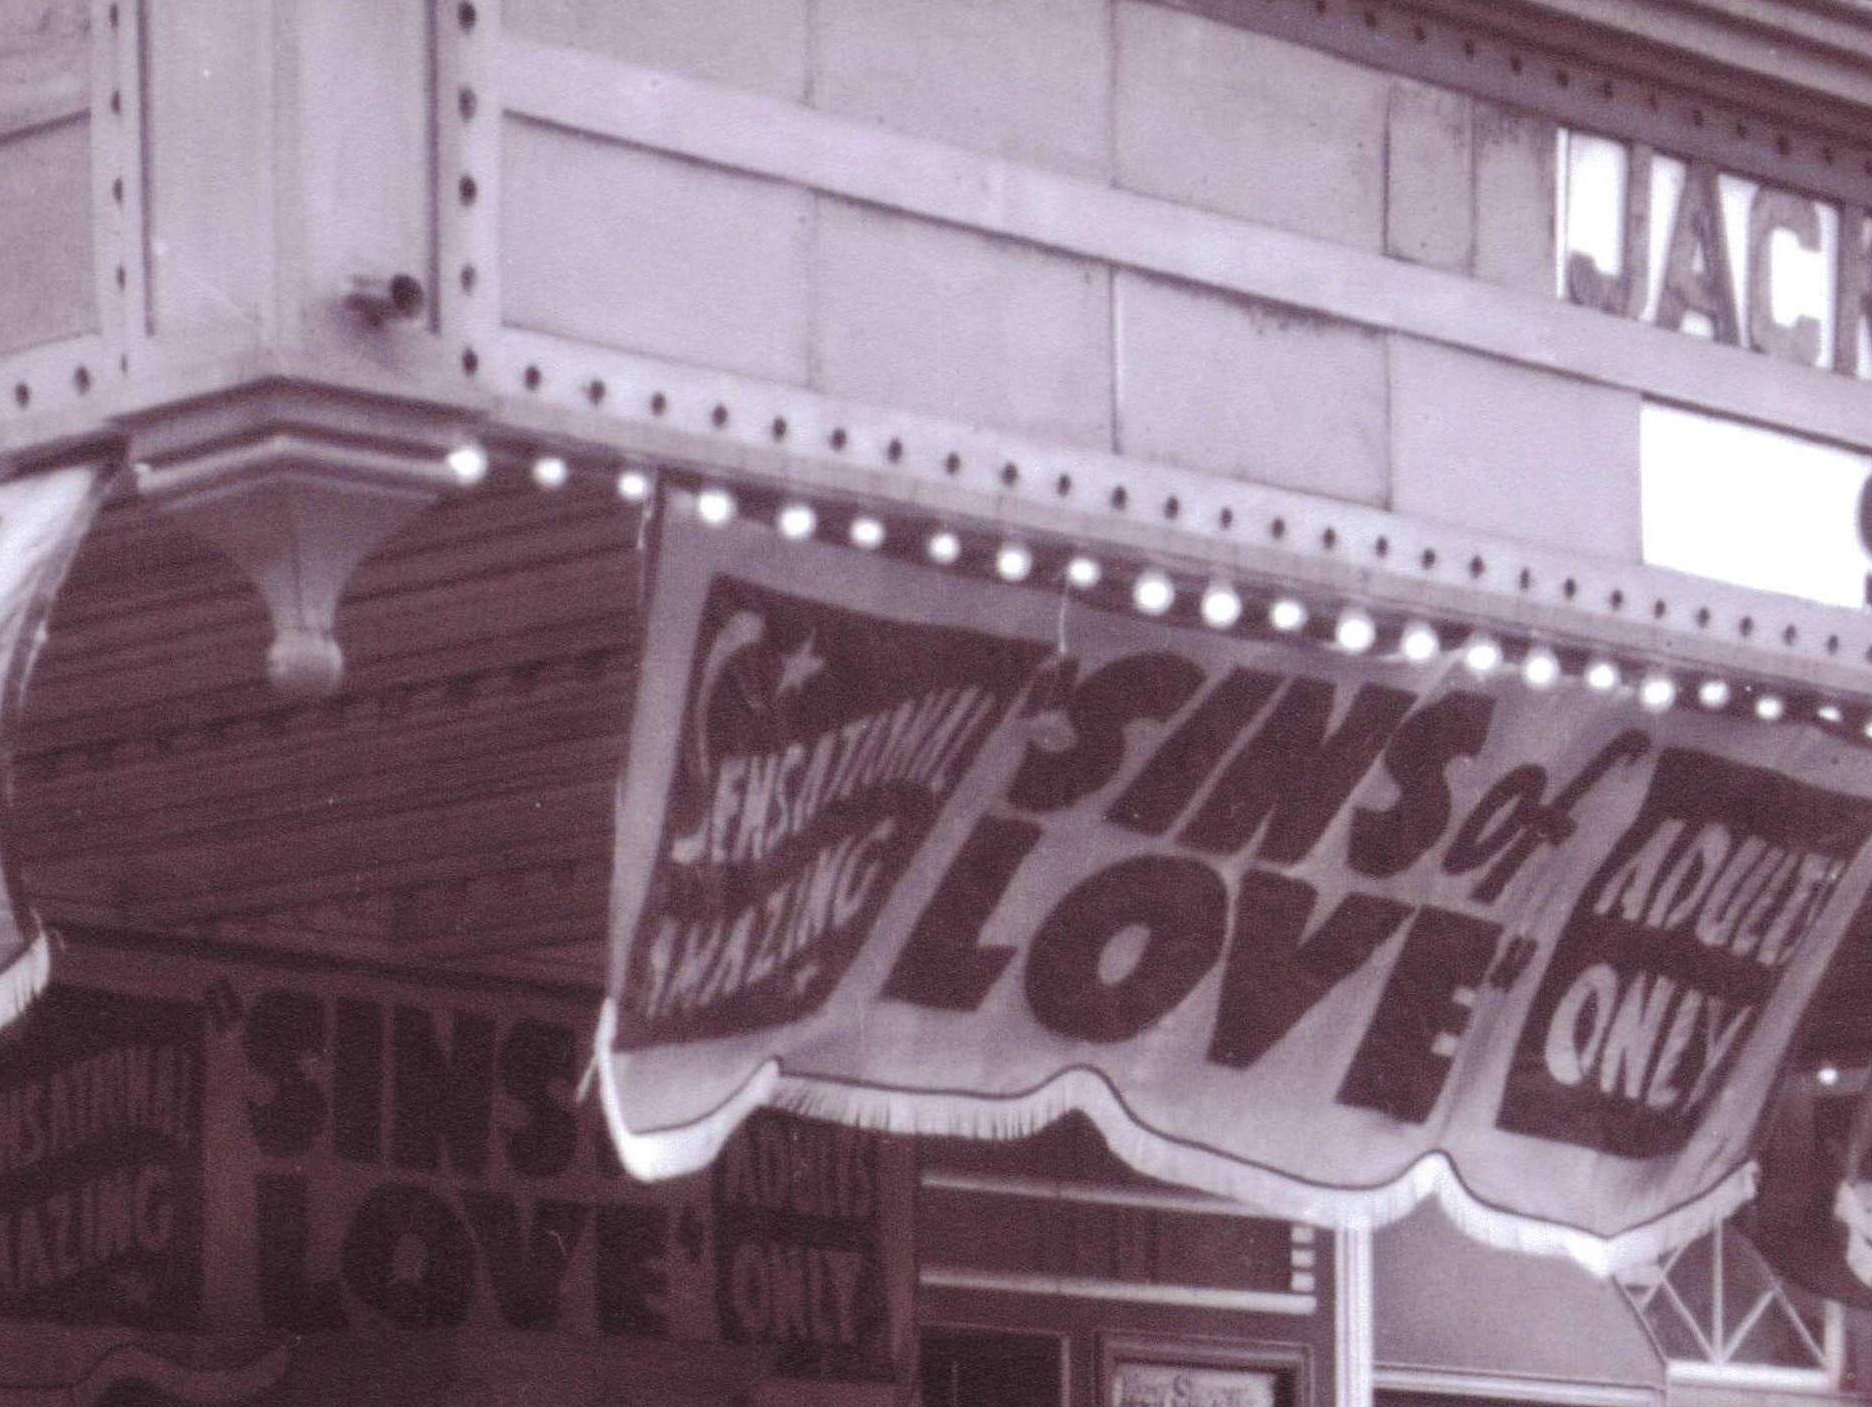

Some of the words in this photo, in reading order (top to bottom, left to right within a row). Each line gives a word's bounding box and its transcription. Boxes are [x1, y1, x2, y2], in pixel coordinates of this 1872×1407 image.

[670, 610, 997, 865] SENSATIONAL
[1441, 728, 1652, 905] of
[642, 815, 897, 1021] AMAZING
[1543, 962, 1754, 1115] ONLY
